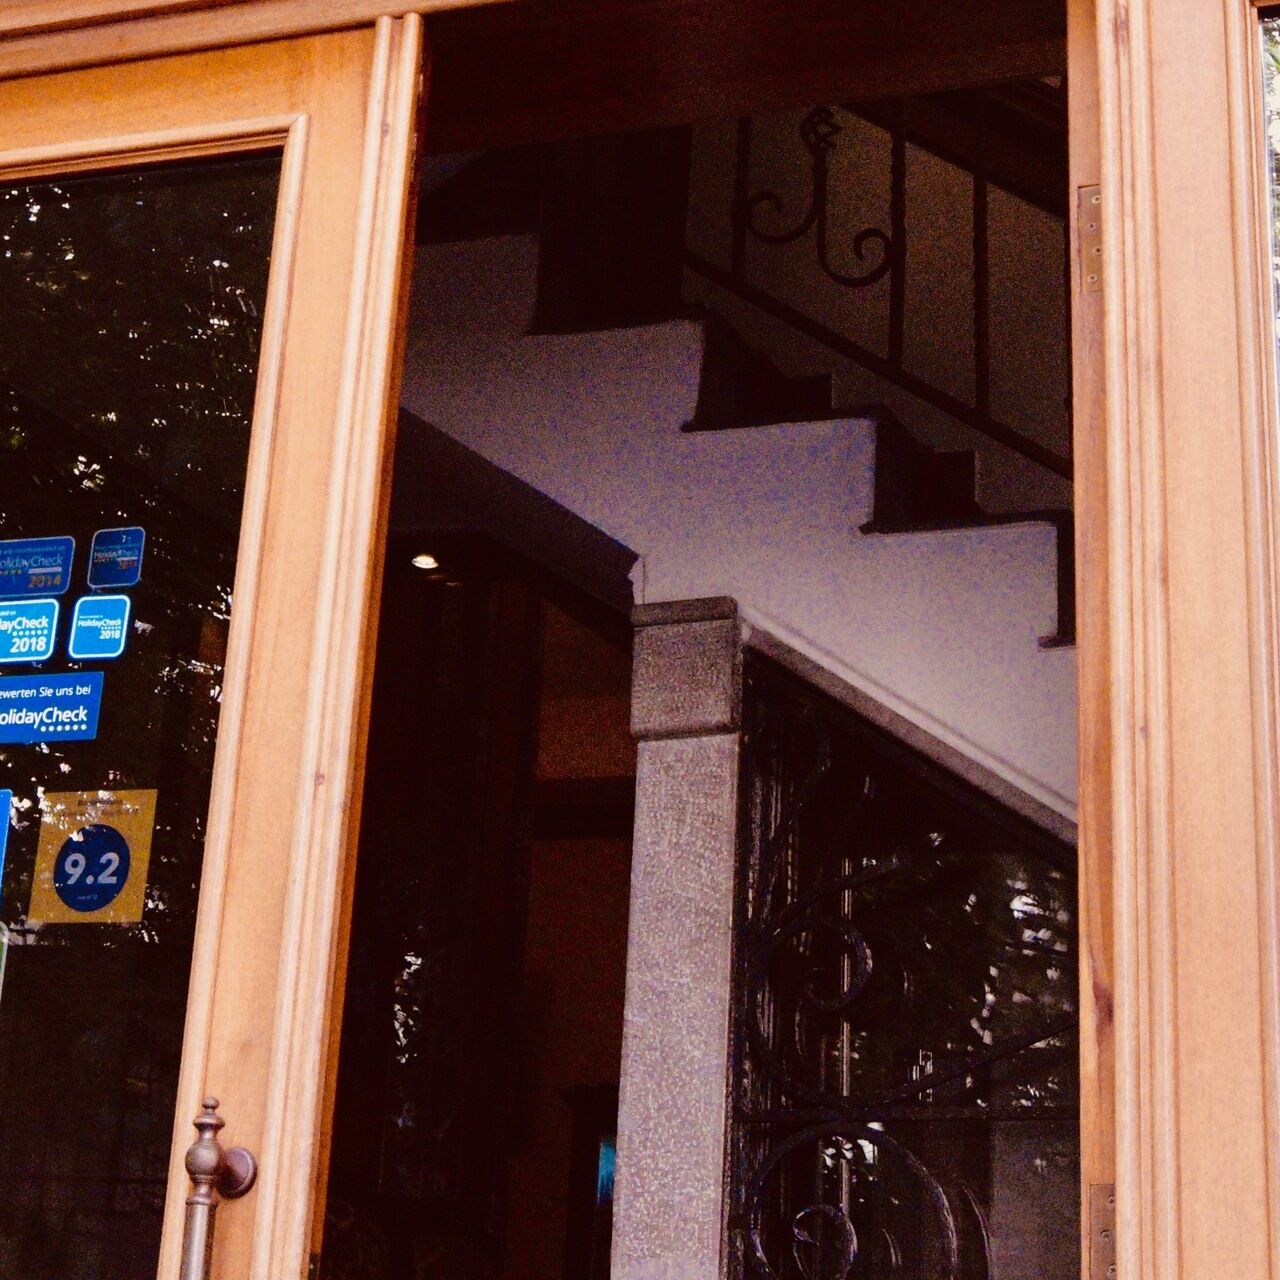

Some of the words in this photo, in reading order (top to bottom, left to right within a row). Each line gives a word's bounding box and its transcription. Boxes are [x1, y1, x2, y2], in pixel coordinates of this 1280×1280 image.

[77, 619, 121, 629] HolidayCheck
[99, 630, 121, 639] 2018
[10, 637, 46, 653] 2018
[39, 686, 53, 697] Sie
[55, 687, 73, 696] uns
[75, 684, 91, 696] bei
[64, 852, 120, 885] 9.2
